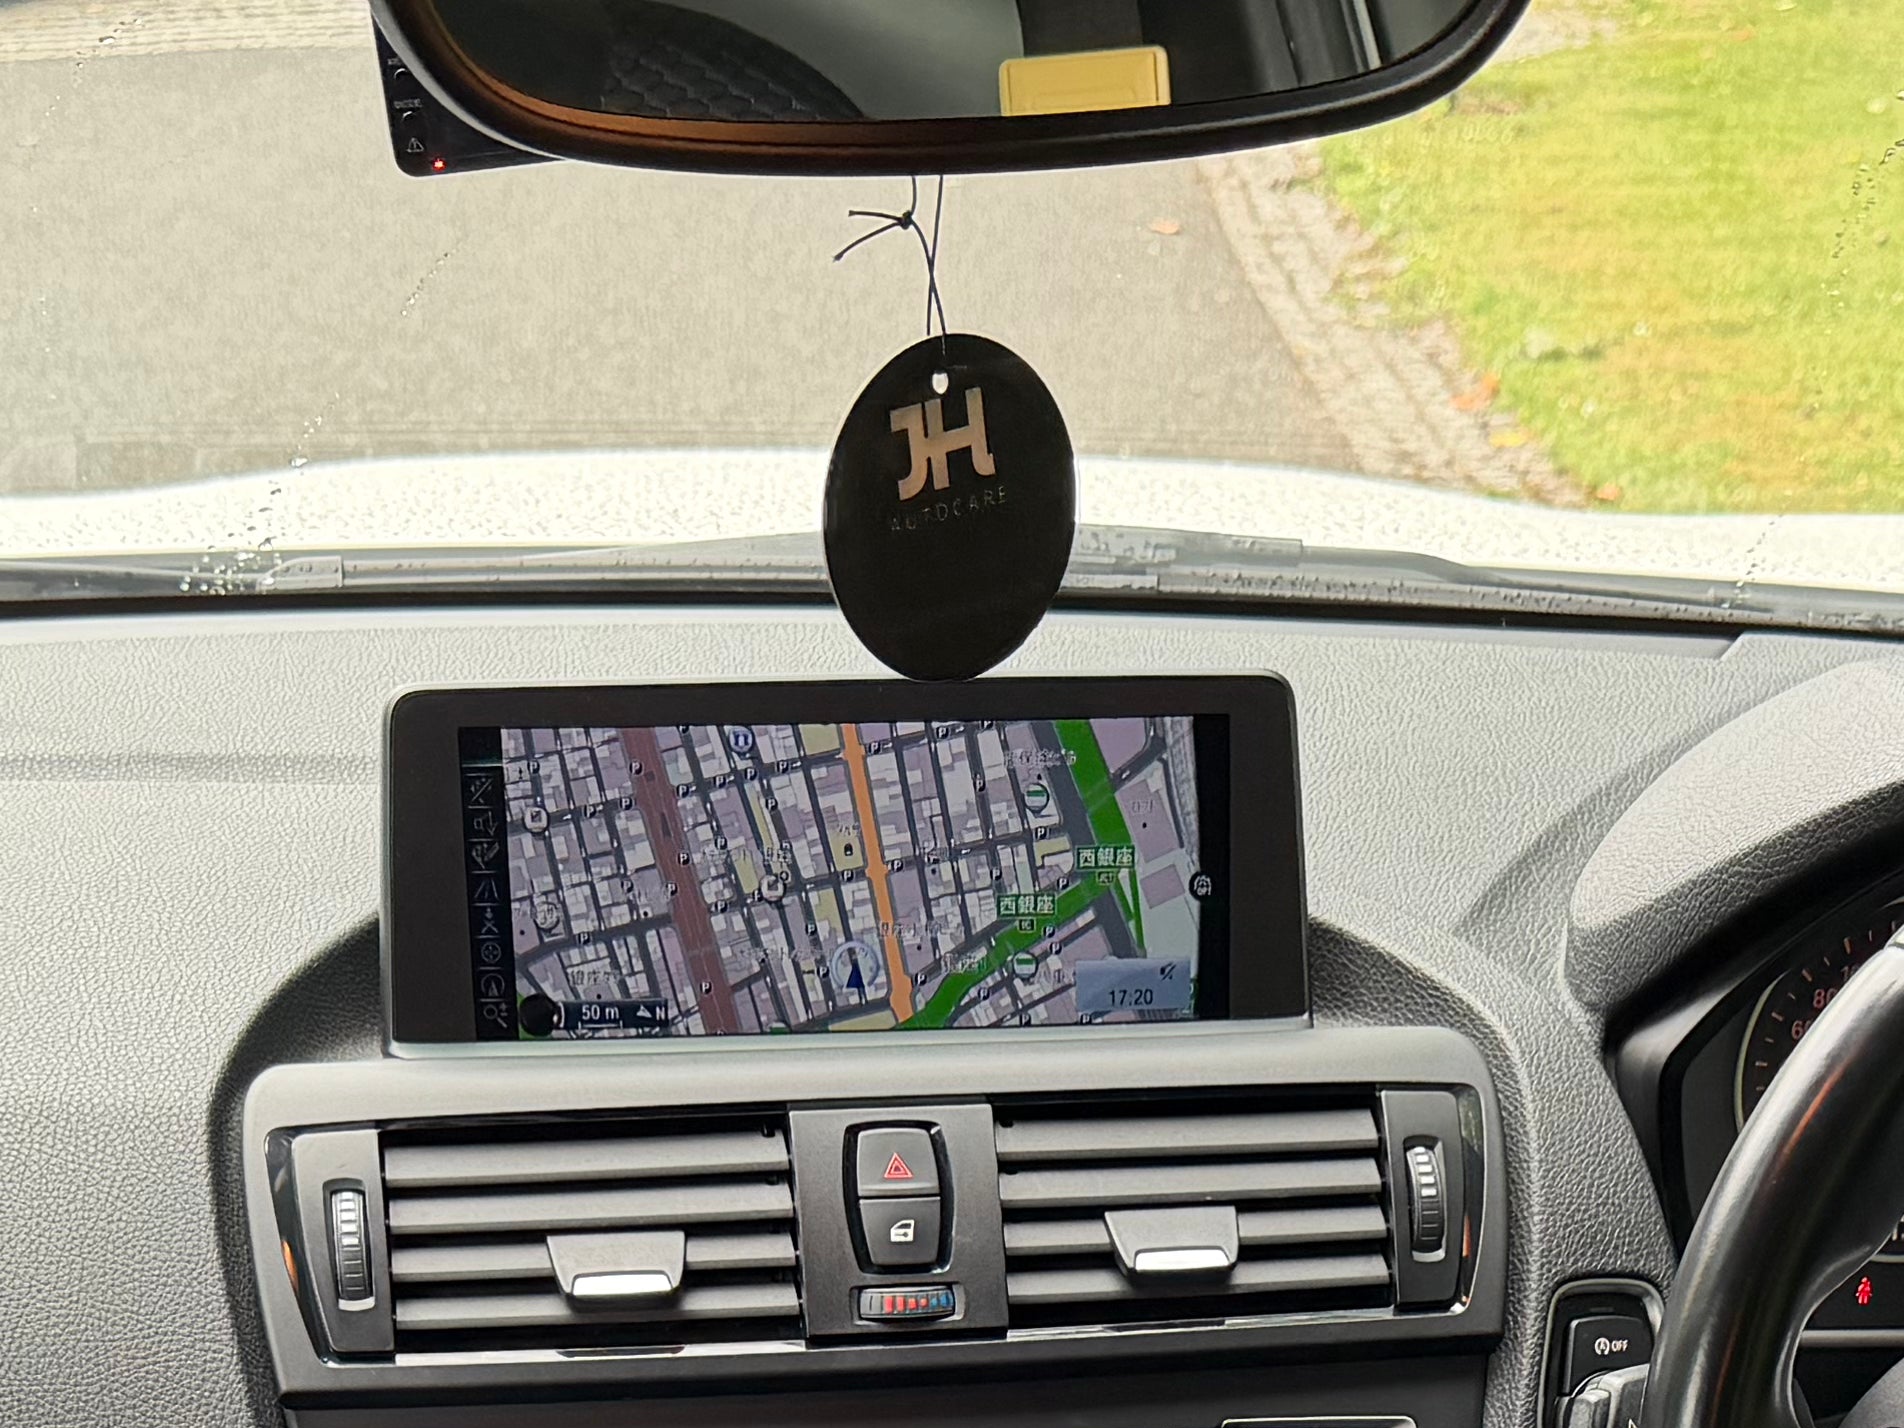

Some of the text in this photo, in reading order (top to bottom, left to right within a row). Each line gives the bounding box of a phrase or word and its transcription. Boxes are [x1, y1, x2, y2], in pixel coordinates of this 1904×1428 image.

[890, 386, 996, 501] JH
[891, 485, 1008, 531] AUTOCARE
[1079, 846, 1133, 868] 西銀座
[1000, 894, 1054, 915] 西銀座
[1109, 988, 1154, 1007] 17:20
[581, 1005, 620, 1020] 50 m
